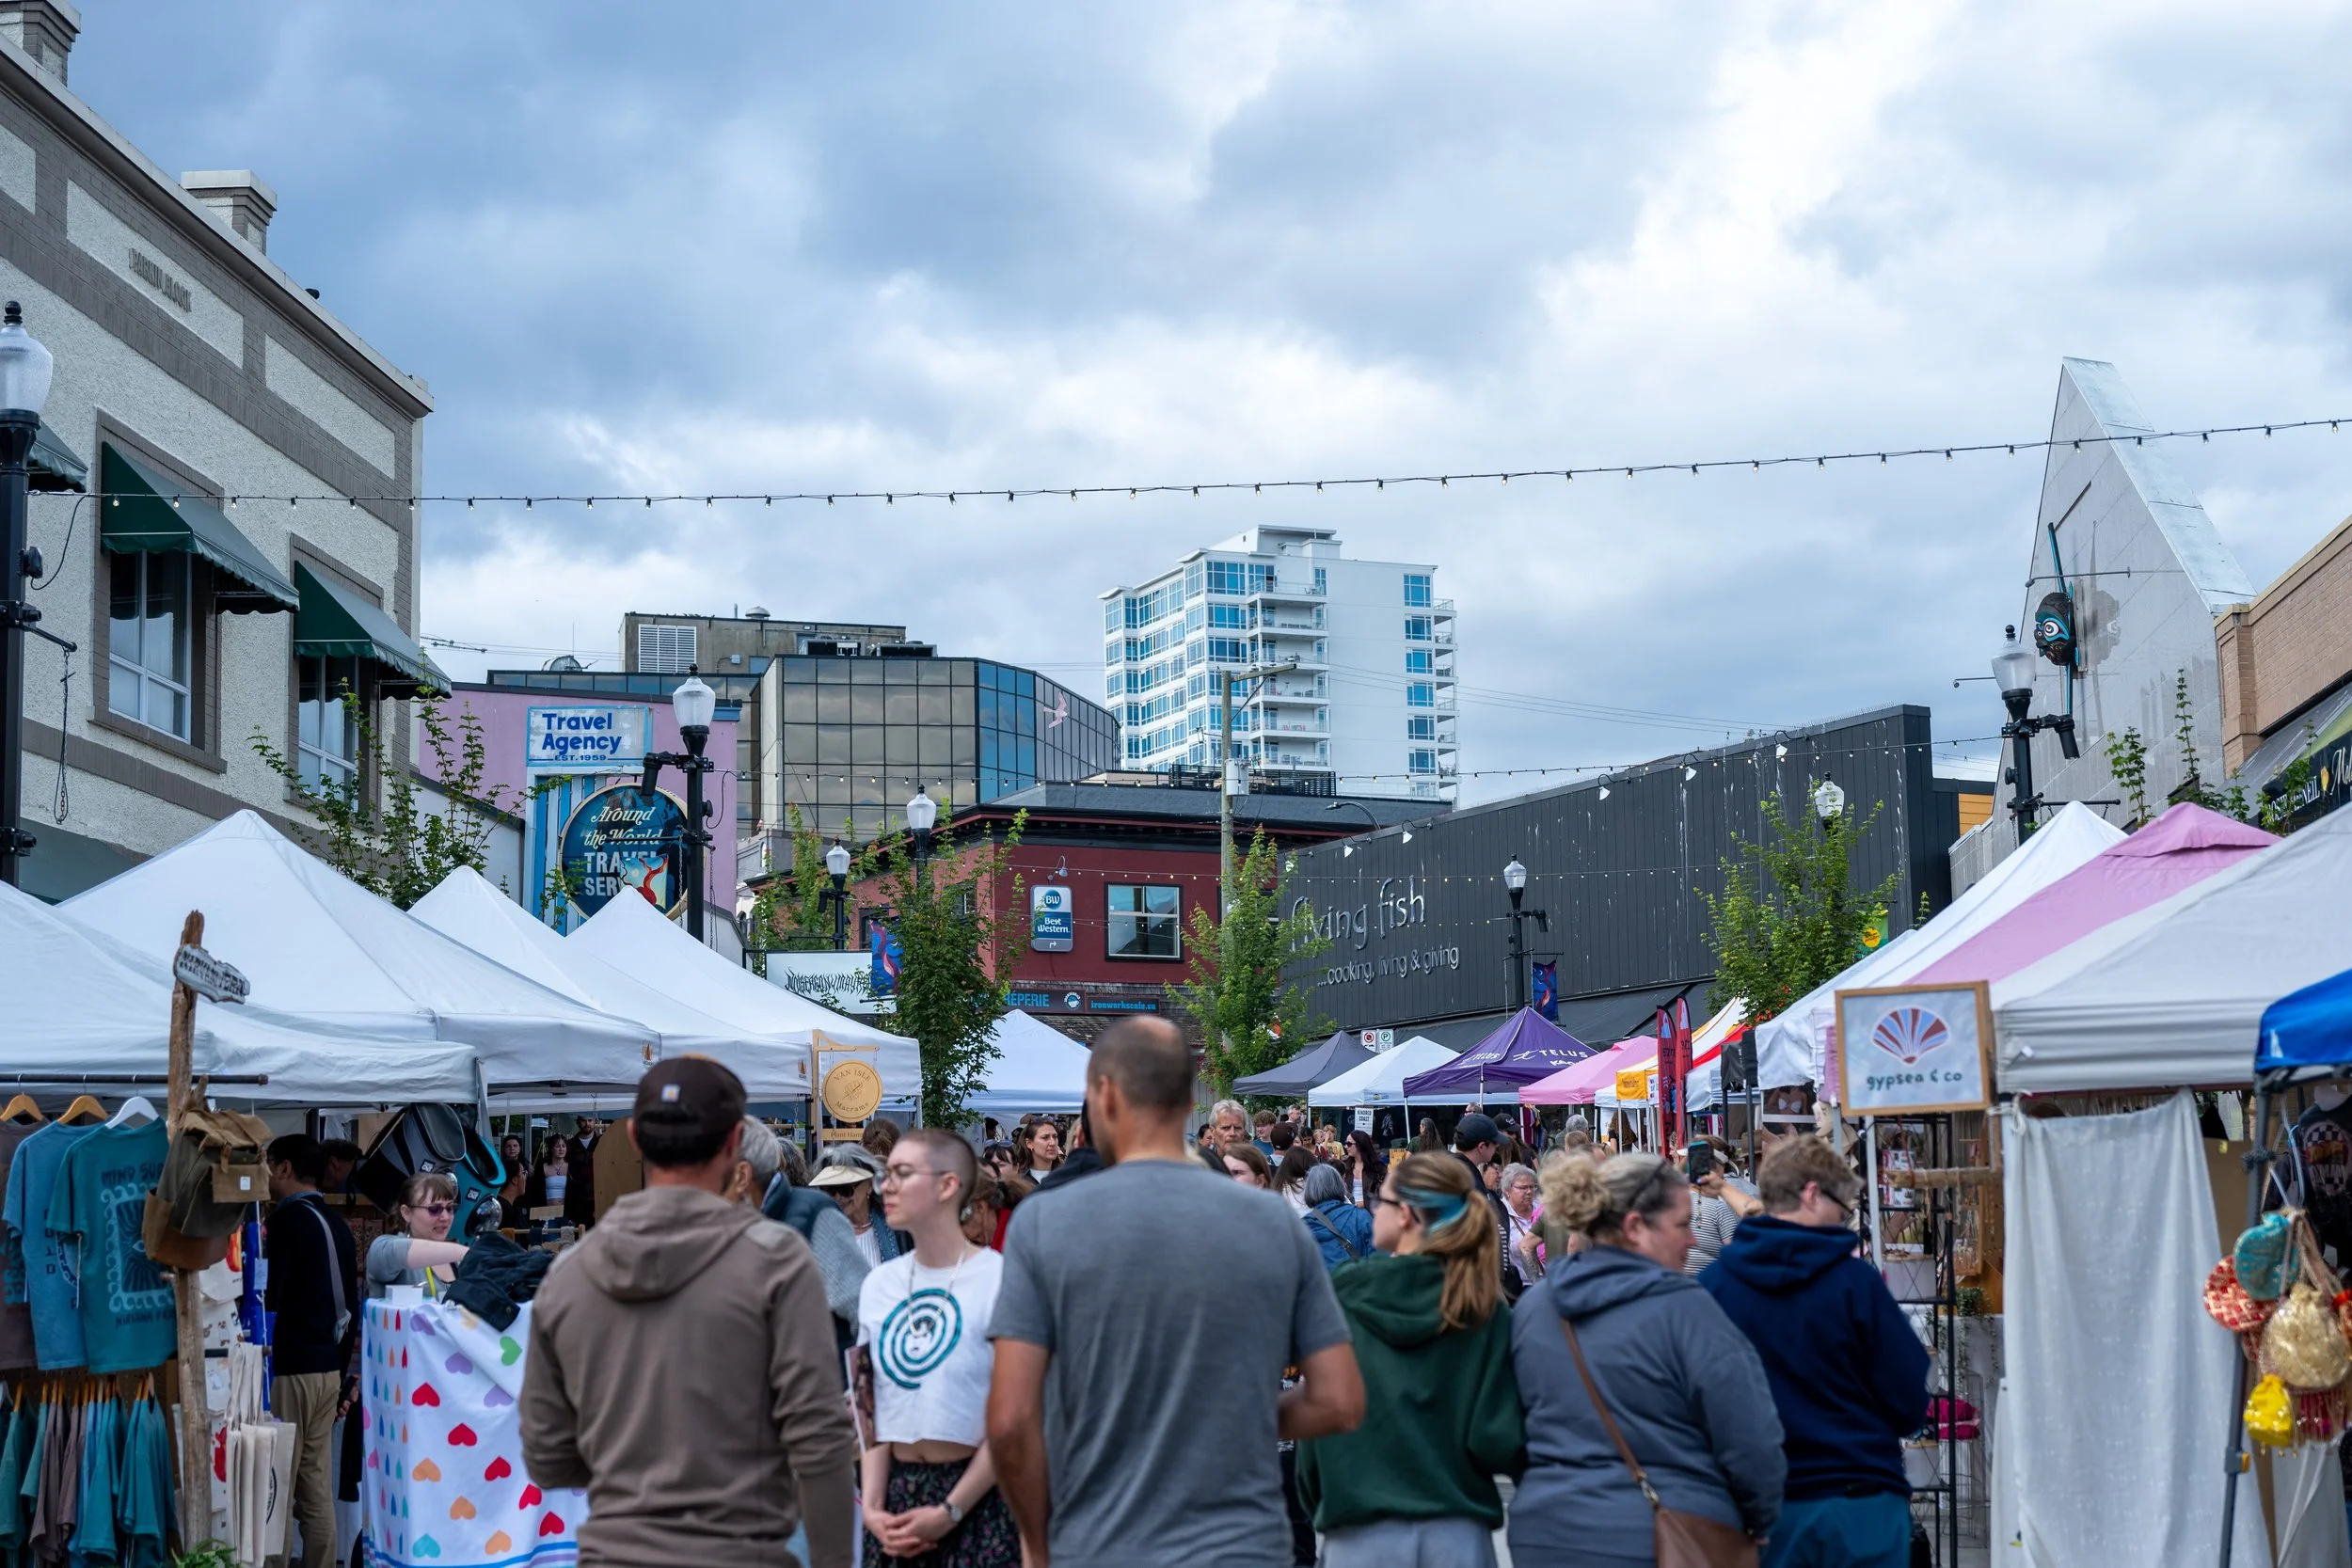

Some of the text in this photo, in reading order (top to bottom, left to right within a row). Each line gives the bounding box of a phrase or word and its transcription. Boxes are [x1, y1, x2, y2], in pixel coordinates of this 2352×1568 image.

[542, 712, 612, 731] Travel
[542, 733, 622, 754] Agency
[591, 806, 657, 825] Around
[583, 830, 663, 848] the World
[584, 852, 658, 874] TRA
[1045, 895, 1060, 905] BW
[1377, 875, 1425, 939] fish
[1044, 917, 1061, 926] Best
[1411, 949, 1421, 971] &
[1423, 946, 1459, 974] giving
[1539, 1049, 1588, 1058] TELUS
[834, 1069, 851, 1081] VAN
[1867, 1070, 1924, 1091] gypsea
[1944, 1071, 1963, 1083] co
[101, 1166, 135, 1185] MIND
